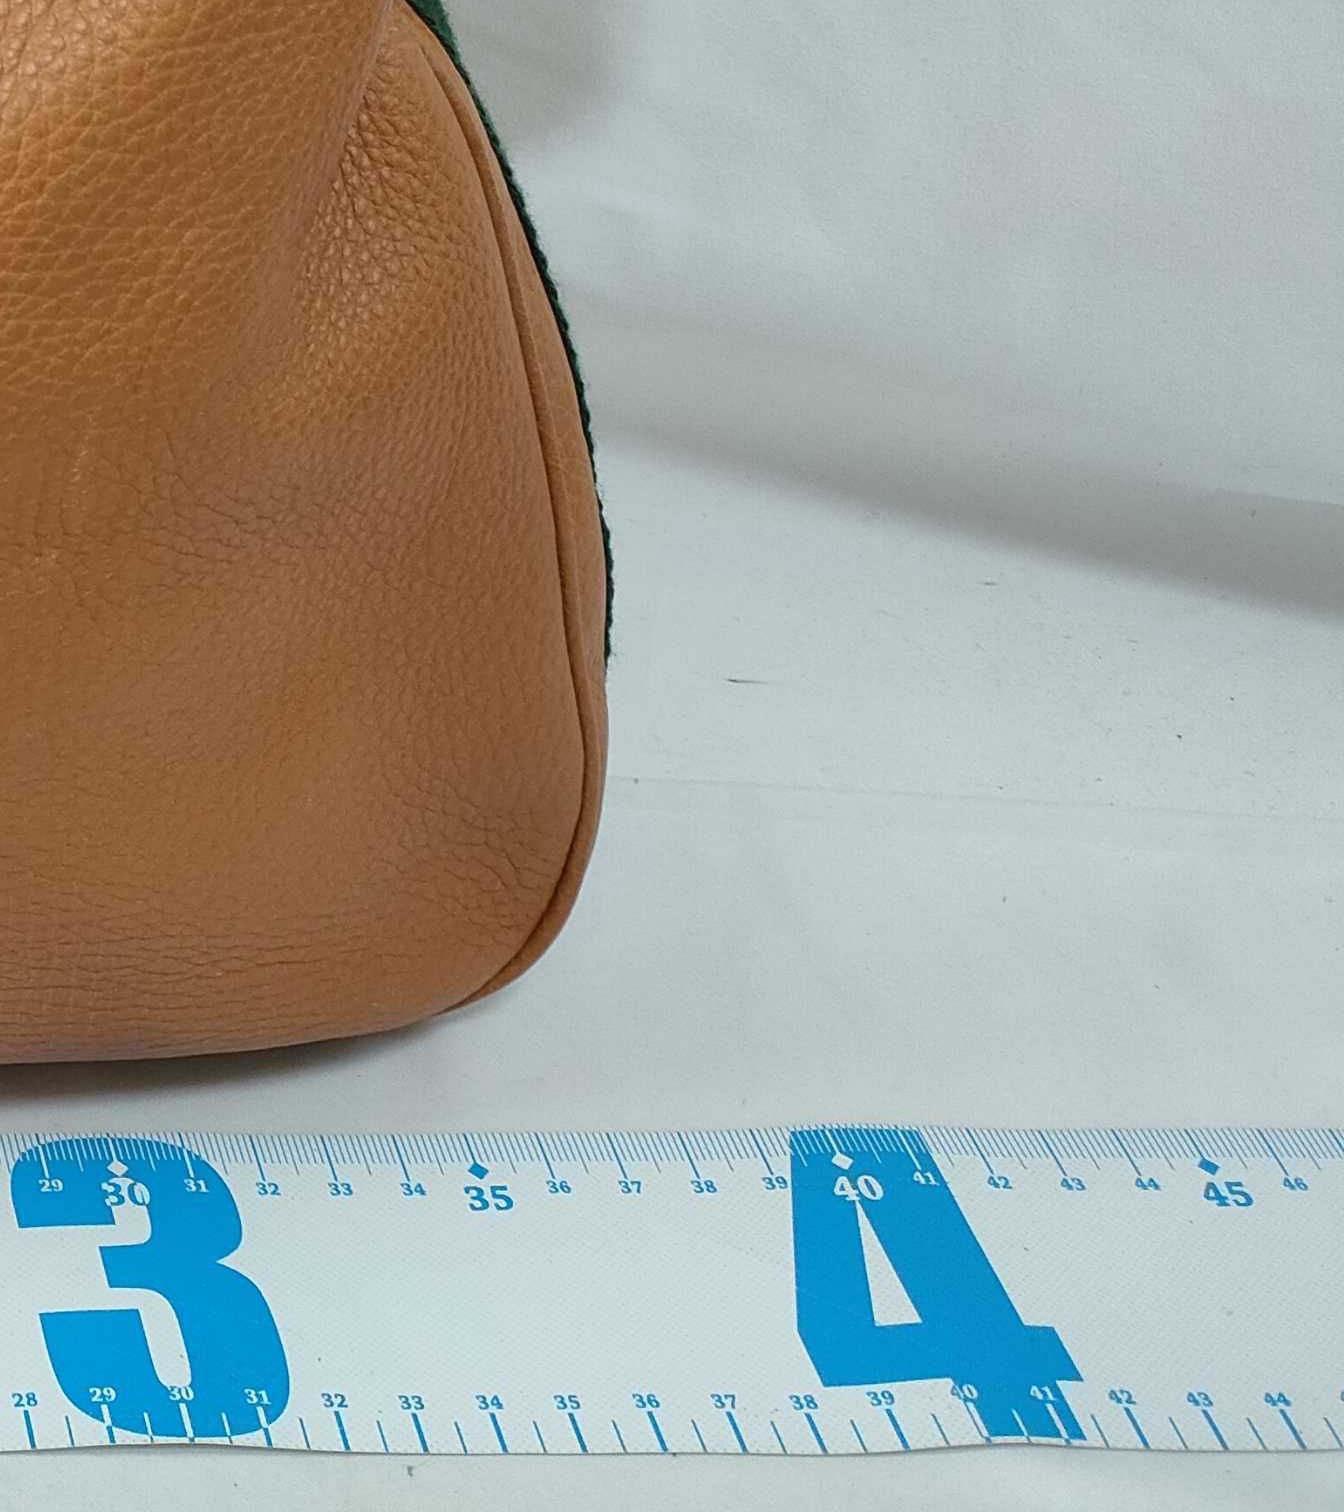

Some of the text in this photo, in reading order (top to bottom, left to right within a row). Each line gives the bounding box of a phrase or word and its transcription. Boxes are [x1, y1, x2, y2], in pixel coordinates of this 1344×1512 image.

[38, 1179, 64, 1193] 29
[103, 1181, 151, 1208] 30
[184, 1180, 210, 1194] 31
[256, 1182, 281, 1197] 32
[328, 1183, 354, 1197] 33
[400, 1183, 427, 1197] 34
[464, 1185, 514, 1212] 35
[546, 1179, 572, 1194] 36
[618, 1179, 643, 1194] 37
[691, 1179, 717, 1194] 38
[761, 1176, 788, 1190] 39
[832, 1175, 884, 1202] 40
[912, 1171, 939, 1187] 41
[986, 1175, 1013, 1190] 42
[1060, 1177, 1086, 1192] 43
[1134, 1176, 1161, 1192] 44
[1203, 1181, 1254, 1207] 45
[1282, 1176, 1308, 1192] 46
[10, 1137, 290, 1437] 3
[790, 1127, 1084, 1440] 4
[12, 1392, 38, 1407] 28
[88, 1387, 117, 1402] 29
[167, 1387, 194, 1401] 30
[245, 1389, 272, 1405] 31
[321, 1393, 349, 1409] 32
[399, 1394, 426, 1410] 33
[476, 1394, 504, 1410] 34
[553, 1393, 582, 1410] 35
[632, 1393, 660, 1409] 36
[710, 1393, 738, 1410] 37
[789, 1394, 818, 1410] 38
[866, 1391, 896, 1407] 39
[950, 1385, 978, 1401] 40
[1030, 1386, 1058, 1401] 41
[1108, 1390, 1137, 1406] 42
[1186, 1392, 1213, 1408] 43
[1264, 1392, 1291, 1408] 44
